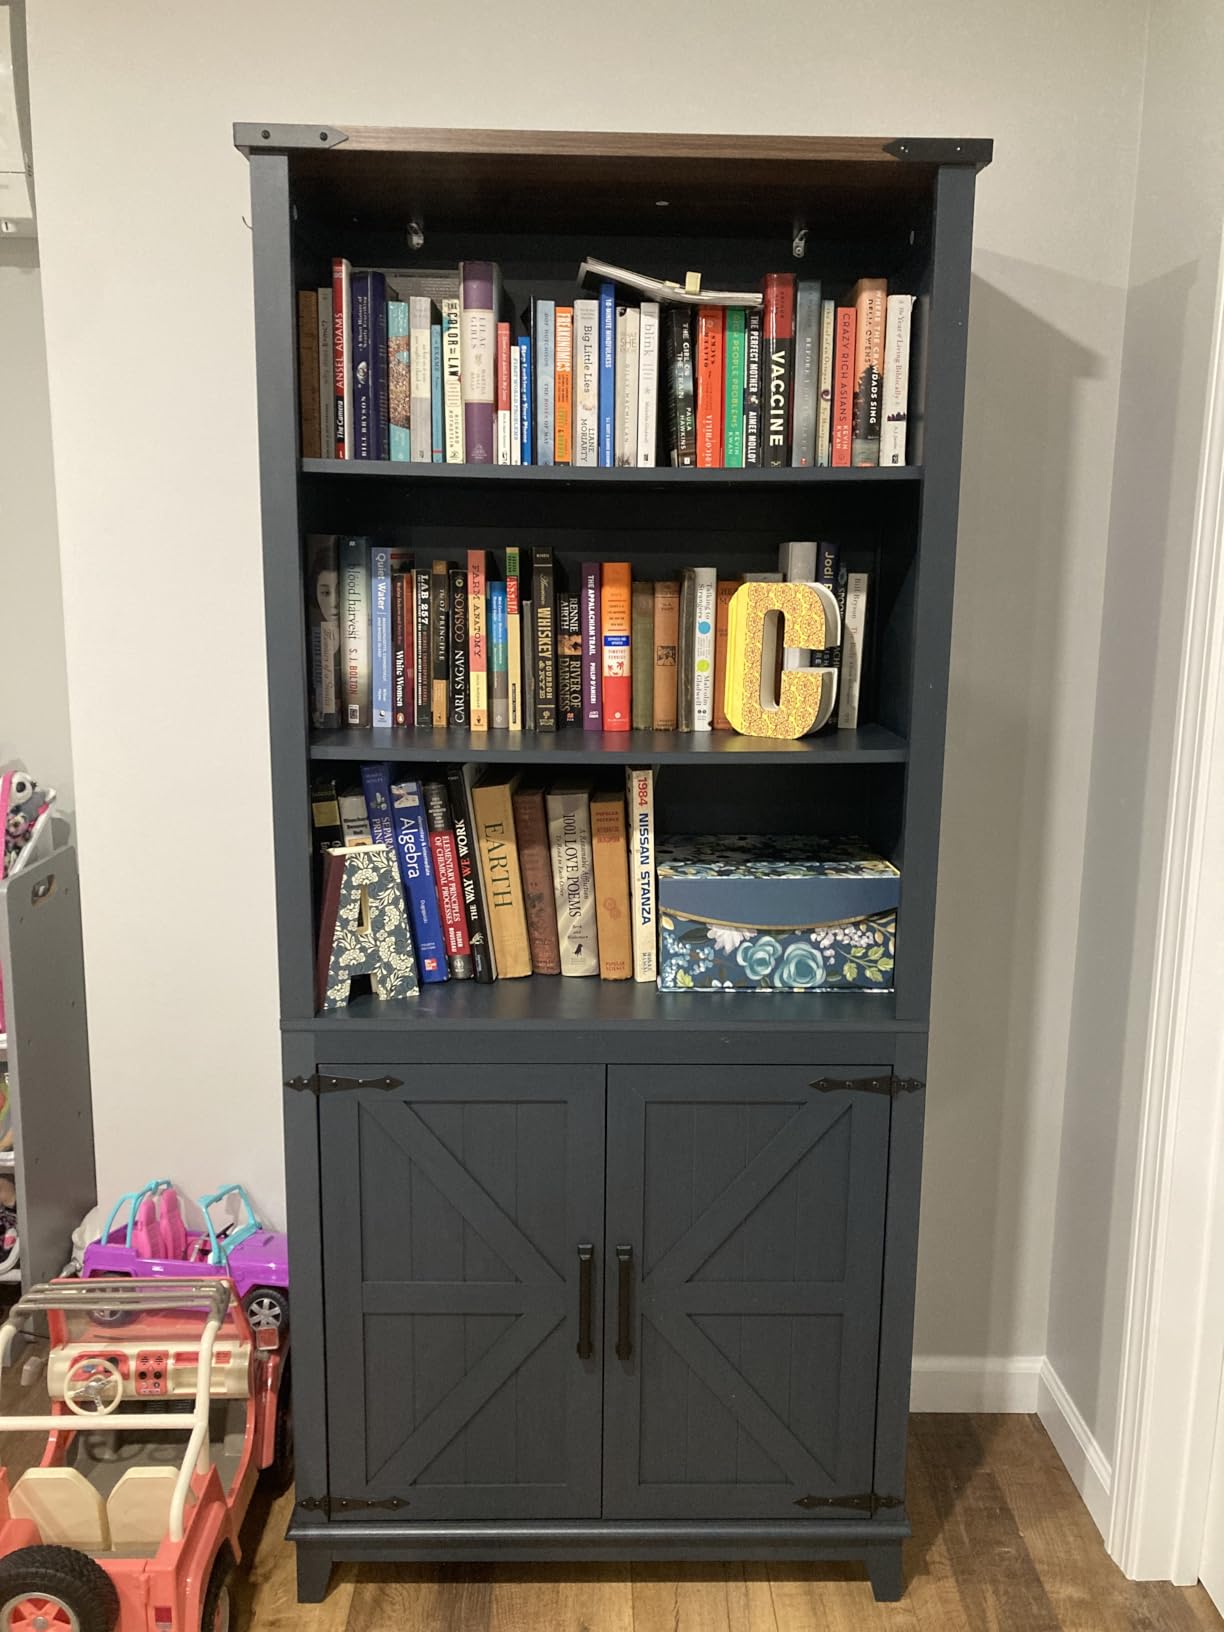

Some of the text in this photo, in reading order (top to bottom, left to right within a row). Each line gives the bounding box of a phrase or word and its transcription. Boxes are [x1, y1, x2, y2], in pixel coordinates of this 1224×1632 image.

[866, 299, 874, 326] DELIA
[874, 291, 882, 322] WHERE
[448, 312, 459, 346] COLOR
[470, 317, 478, 350] GIRLS
[556, 313, 570, 372] FREAKONOMICS
[582, 325, 592, 342] Big
[643, 324, 655, 356] blink
[335, 312, 344, 390] ANSEL ADAMS
[448, 358, 460, 377] LAW
[520, 345, 528, 362] Stop
[584, 344, 592, 371] Little
[684, 364, 690, 376] ON
[749, 316, 759, 392] THE PERFECT MOTHER
[804, 338, 812, 374] BEFORE
[839, 314, 850, 422] CRAZY RICH ASIANS
[895, 340, 904, 363] Living
[520, 364, 528, 393] Looking
[584, 374, 592, 394] Lies
[730, 340, 740, 428] PEOPLE PROBLEMS
[871, 347, 880, 399] CRAWDADS
[893, 365, 902, 400] Biblically
[770, 350, 786, 446] VACCINE
[869, 401, 878, 424] SING
[336, 400, 344, 440] The Camera
[748, 412, 757, 462] AIMEE MOLLOY
[376, 553, 386, 610] Quiet Water
[587, 575, 595, 588] THE
[823, 552, 835, 579] Jodi
[346, 562, 362, 640] blood harvest
[439, 600, 445, 611] OZ
[472, 565, 482, 658] FARM ANATOMY
[507, 577, 518, 614] ASSATA
[560, 600, 570, 629] AIRTH
[588, 589, 596, 636] APPALACHIAN
[696, 584, 705, 619] Strangers
[704, 582, 713, 620] Talking to
[850, 578, 862, 619] Bill Bryson
[454, 593, 464, 642] COSMOS
[537, 608, 552, 658] WHISKEY
[570, 598, 579, 633] RENNIE
[349, 648, 358, 656] S.
[725, 581, 841, 740] C
[348, 666, 358, 695] BOLTON
[396, 650, 404, 707] White Women
[454, 650, 464, 723] CARL SAGAN
[559, 658, 570, 711] DARKNESS
[570, 661, 582, 708] RIVER OF
[638, 776, 648, 807] 1984
[562, 815, 577, 834] 1001
[398, 817, 422, 878] Algebra
[417, 816, 427, 842] elementary
[422, 847, 431, 876] intermediate
[564, 840, 579, 873] LOVE
[434, 837, 453, 925] OF CHEMICAL PROCESSES
[442, 836, 460, 922] ELEMENTARY PRINCIPLES
[455, 820, 479, 921] THE WAY WE WORK
[484, 822, 513, 909] EARTH
[557, 866, 565, 881] Each
[579, 835, 590, 900] Reasonable Affliction
[639, 813, 651, 926] NISSAN STANZA
[566, 877, 582, 918] POEMS
[324, 845, 420, 1009] A
[448, 928, 457, 953] ROUSSEAU
[456, 931, 464, 948] FELDER
